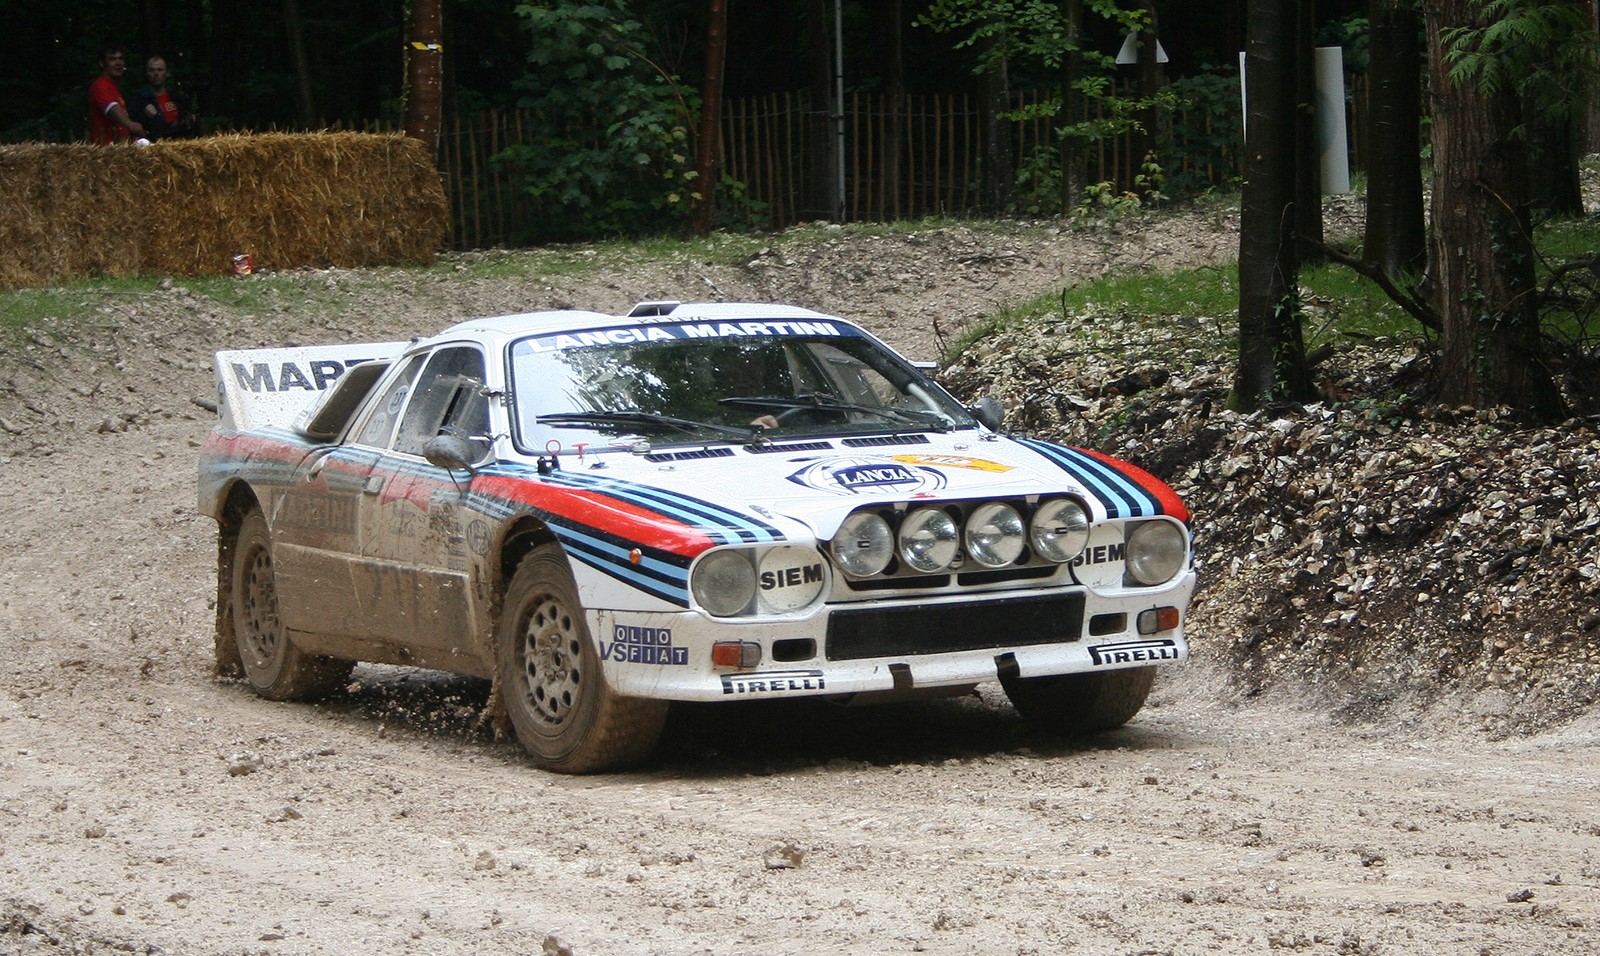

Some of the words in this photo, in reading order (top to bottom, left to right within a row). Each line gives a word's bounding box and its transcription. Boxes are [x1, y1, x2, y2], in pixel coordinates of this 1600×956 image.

[527, 326, 676, 352] LANCIA
[680, 321, 841, 337] MARTINI
[844, 469, 914, 485] LANCIA
[760, 564, 823, 590] SIEM
[615, 626, 670, 645] OLIO
[1088, 640, 1178, 666] PIRELLI
[720, 670, 825, 695] PIRELLI
